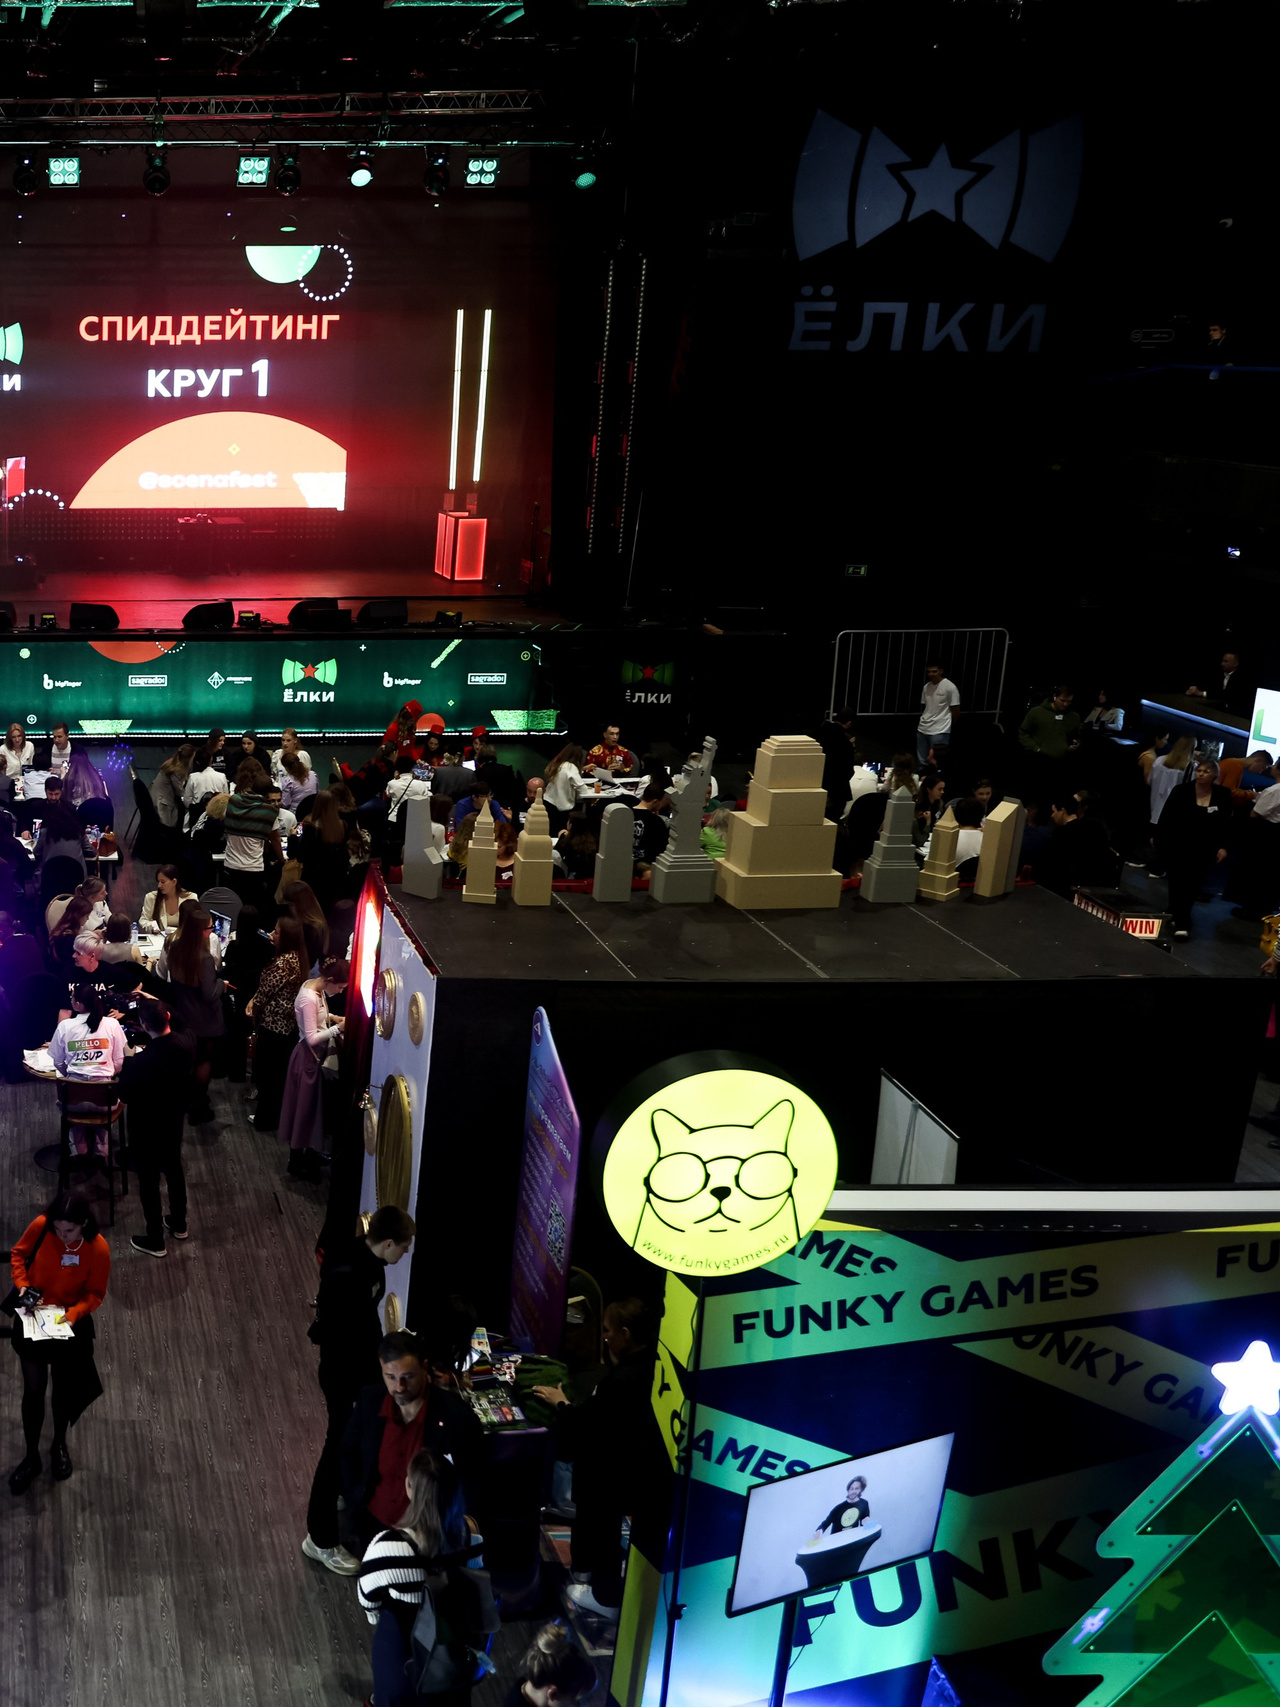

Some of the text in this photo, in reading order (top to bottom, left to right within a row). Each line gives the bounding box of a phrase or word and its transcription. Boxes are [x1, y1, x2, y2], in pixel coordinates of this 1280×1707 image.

[78, 308, 341, 346] СПИДДЕЙТИНГ
[789, 285, 1047, 352] ЁЛКИ
[146, 358, 270, 399] КРУГ 1
[138, 470, 277, 490] @scenafest
[282, 688, 335, 703] ЁЛКИ
[1124, 919, 1157, 934] WIN
[76, 1040, 100, 1049] HELLO
[642, 1234, 790, 1270] www.funkygames.ru
[733, 1290, 905, 1344] FUNKY
[920, 1263, 1099, 1318] GAMES
